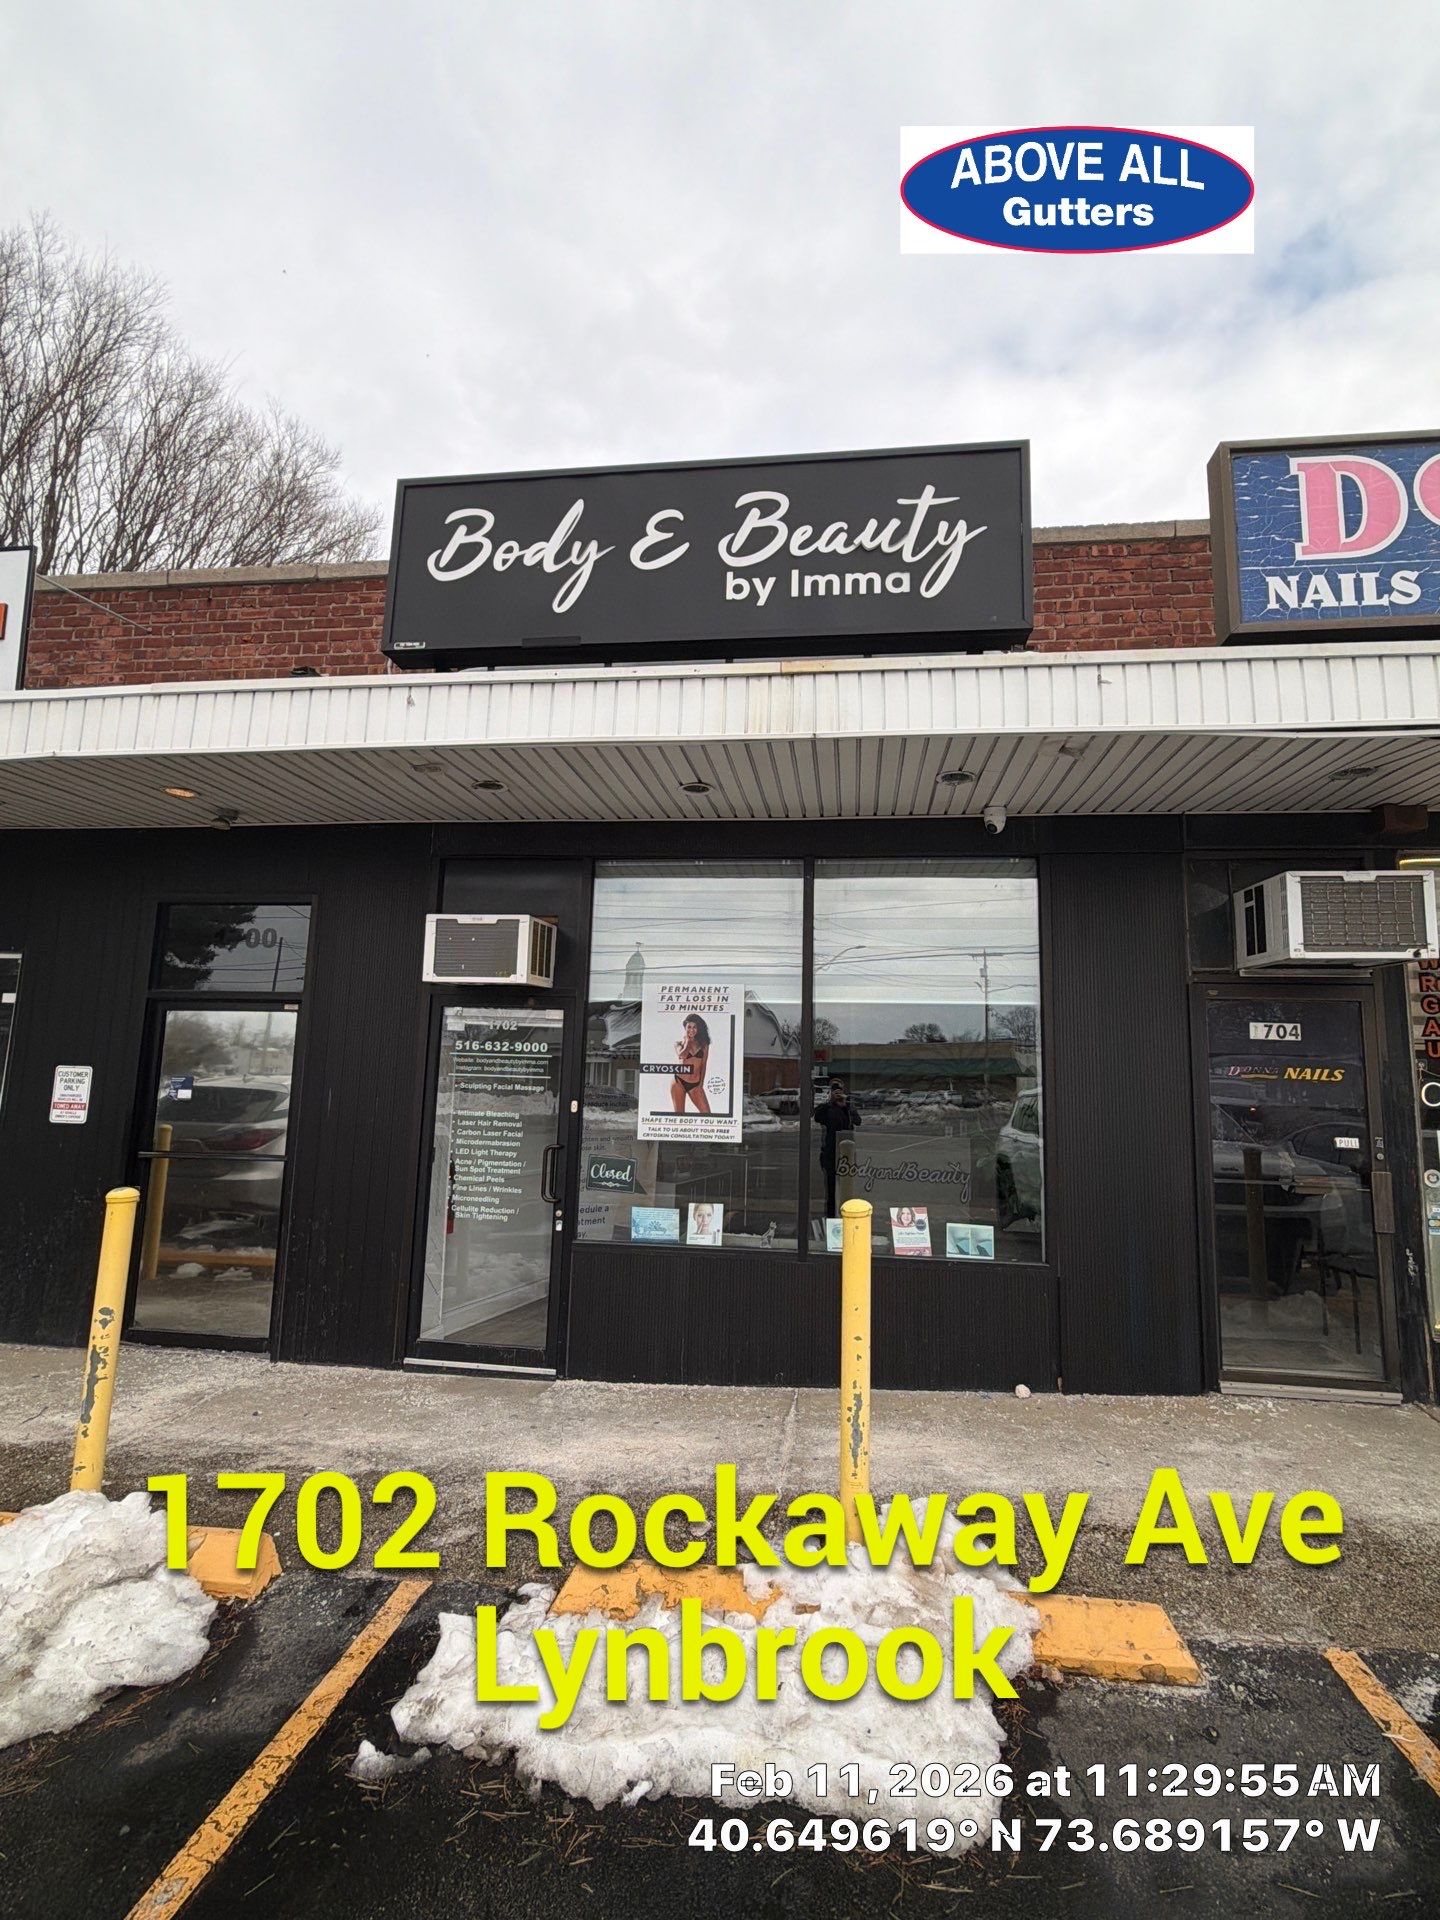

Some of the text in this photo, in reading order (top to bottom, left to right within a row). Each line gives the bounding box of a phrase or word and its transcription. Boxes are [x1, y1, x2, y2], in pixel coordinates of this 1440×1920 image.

[1290, 454, 1440, 561] D
[427, 499, 616, 613] Body
[717, 484, 988, 598] Beauty
[725, 571, 911, 606] by Imma
[1266, 570, 1422, 609] NAILS
[455, 1040, 548, 1053] 516-632-9000
[1283, 1067, 1345, 1082] NAILS
[460, 1082, 545, 1092] Sculpting Facial Massage
[486, 1110, 519, 1119] Bleaching
[493, 1120, 522, 1128] Removal
[457, 1128, 523, 1138] Carbon Laser Facial
[456, 1138, 520, 1147] Microdermabrasion
[1339, 1139, 1359, 1148] PULL
[471, 1148, 488, 1157] Light
[490, 1149, 517, 1158] Therapy
[478, 1159, 522, 1168] Pigmentation
[470, 1166, 485, 1174] Spot
[590, 1163, 633, 1182] Closed
[493, 1186, 522, 1194] Wrinkles
[452, 1194, 500, 1204] Microneedling
[451, 1205, 479, 1213] Cellulite
[481, 1206, 515, 1214] Reduction
[579, 1205, 602, 1214] edule
[472, 1213, 508, 1222] Tightening
